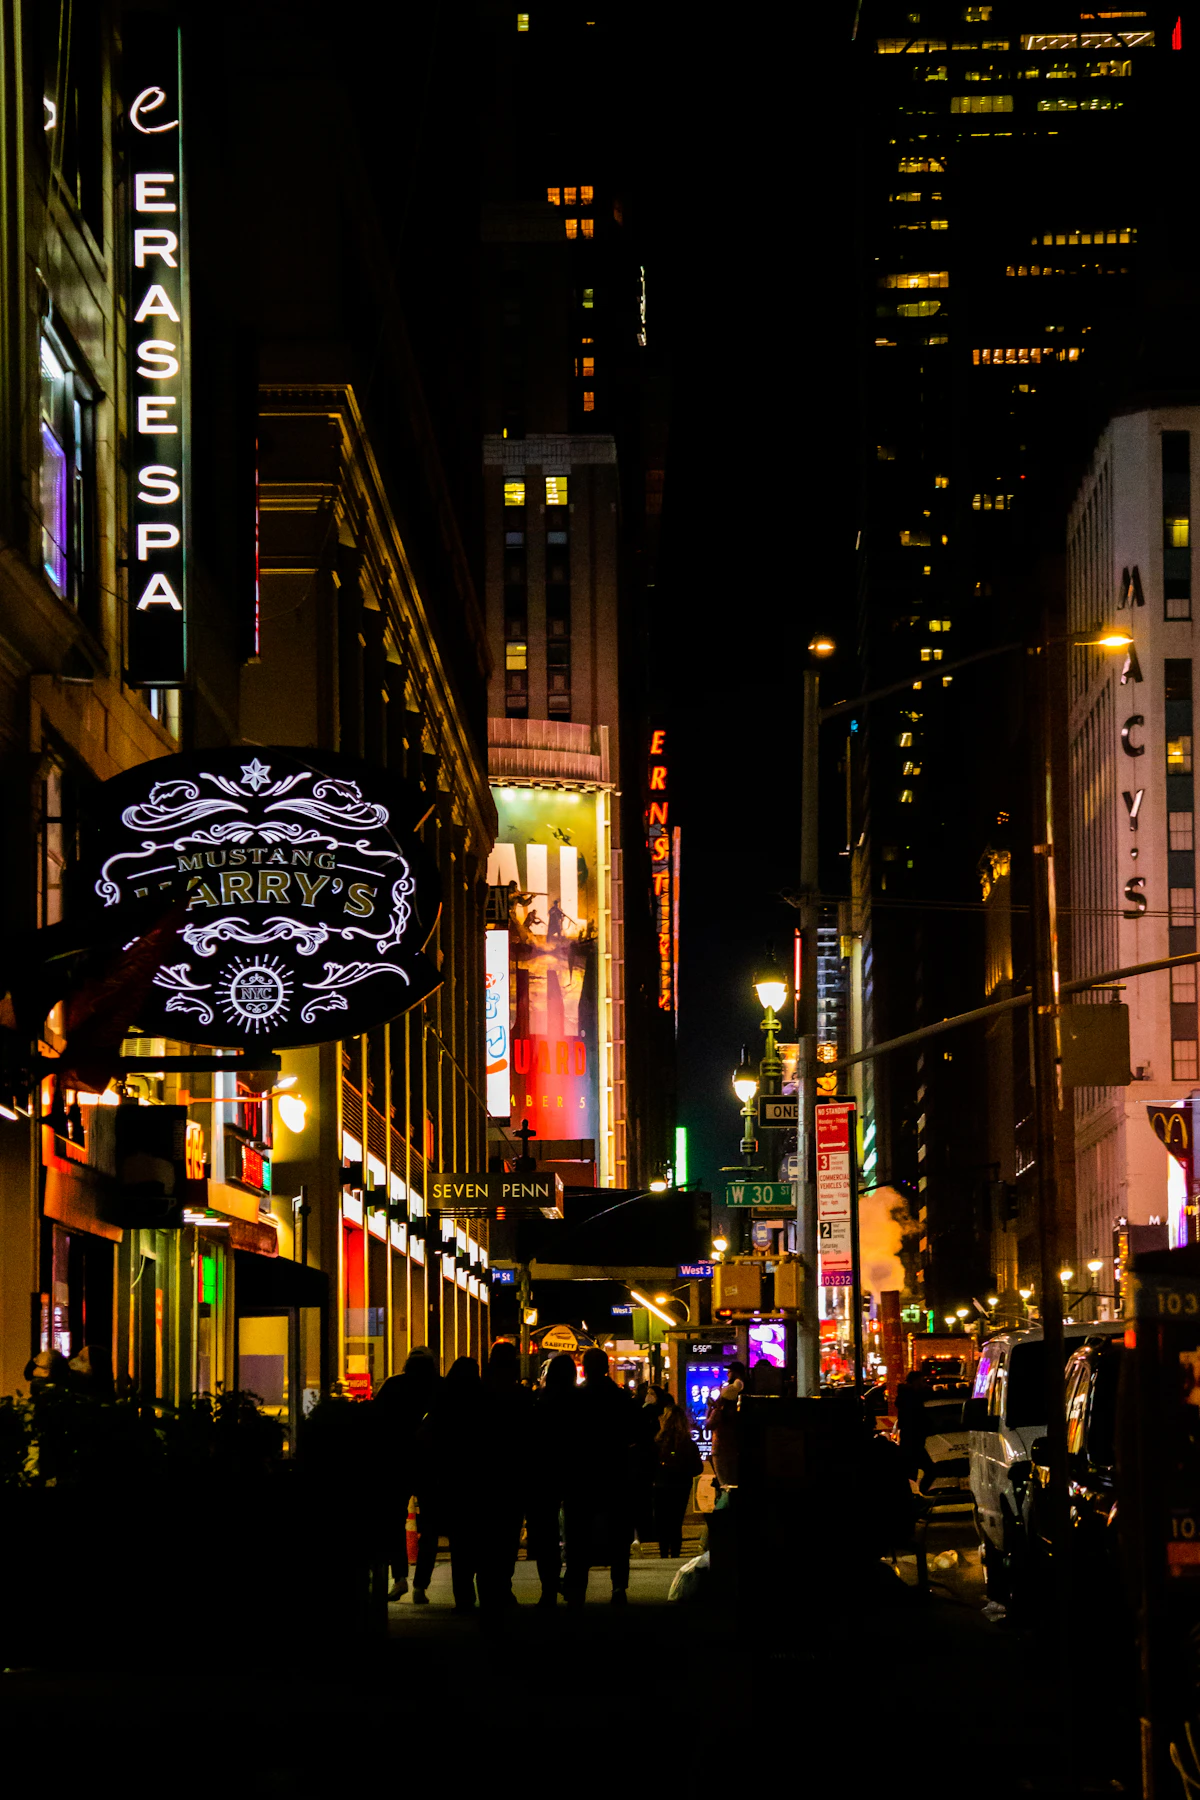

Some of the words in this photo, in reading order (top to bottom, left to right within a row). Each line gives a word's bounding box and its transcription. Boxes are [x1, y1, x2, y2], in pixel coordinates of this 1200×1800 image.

[133, 172, 180, 434] ERASE
[137, 465, 183, 611] SPA
[177, 847, 336, 873] MUSTANG
[240, 987, 273, 1000] NYC
[820, 1155, 828, 1169] 3
[432, 1183, 489, 1198] SEVEN
[502, 1183, 549, 1198] PENN
[731, 1185, 745, 1204] W
[752, 1185, 773, 1204] 30
[780, 1186, 790, 1195] ST
[822, 1223, 830, 1238] 2
[501, 1272, 511, 1281] St
[680, 1265, 704, 1275] West
